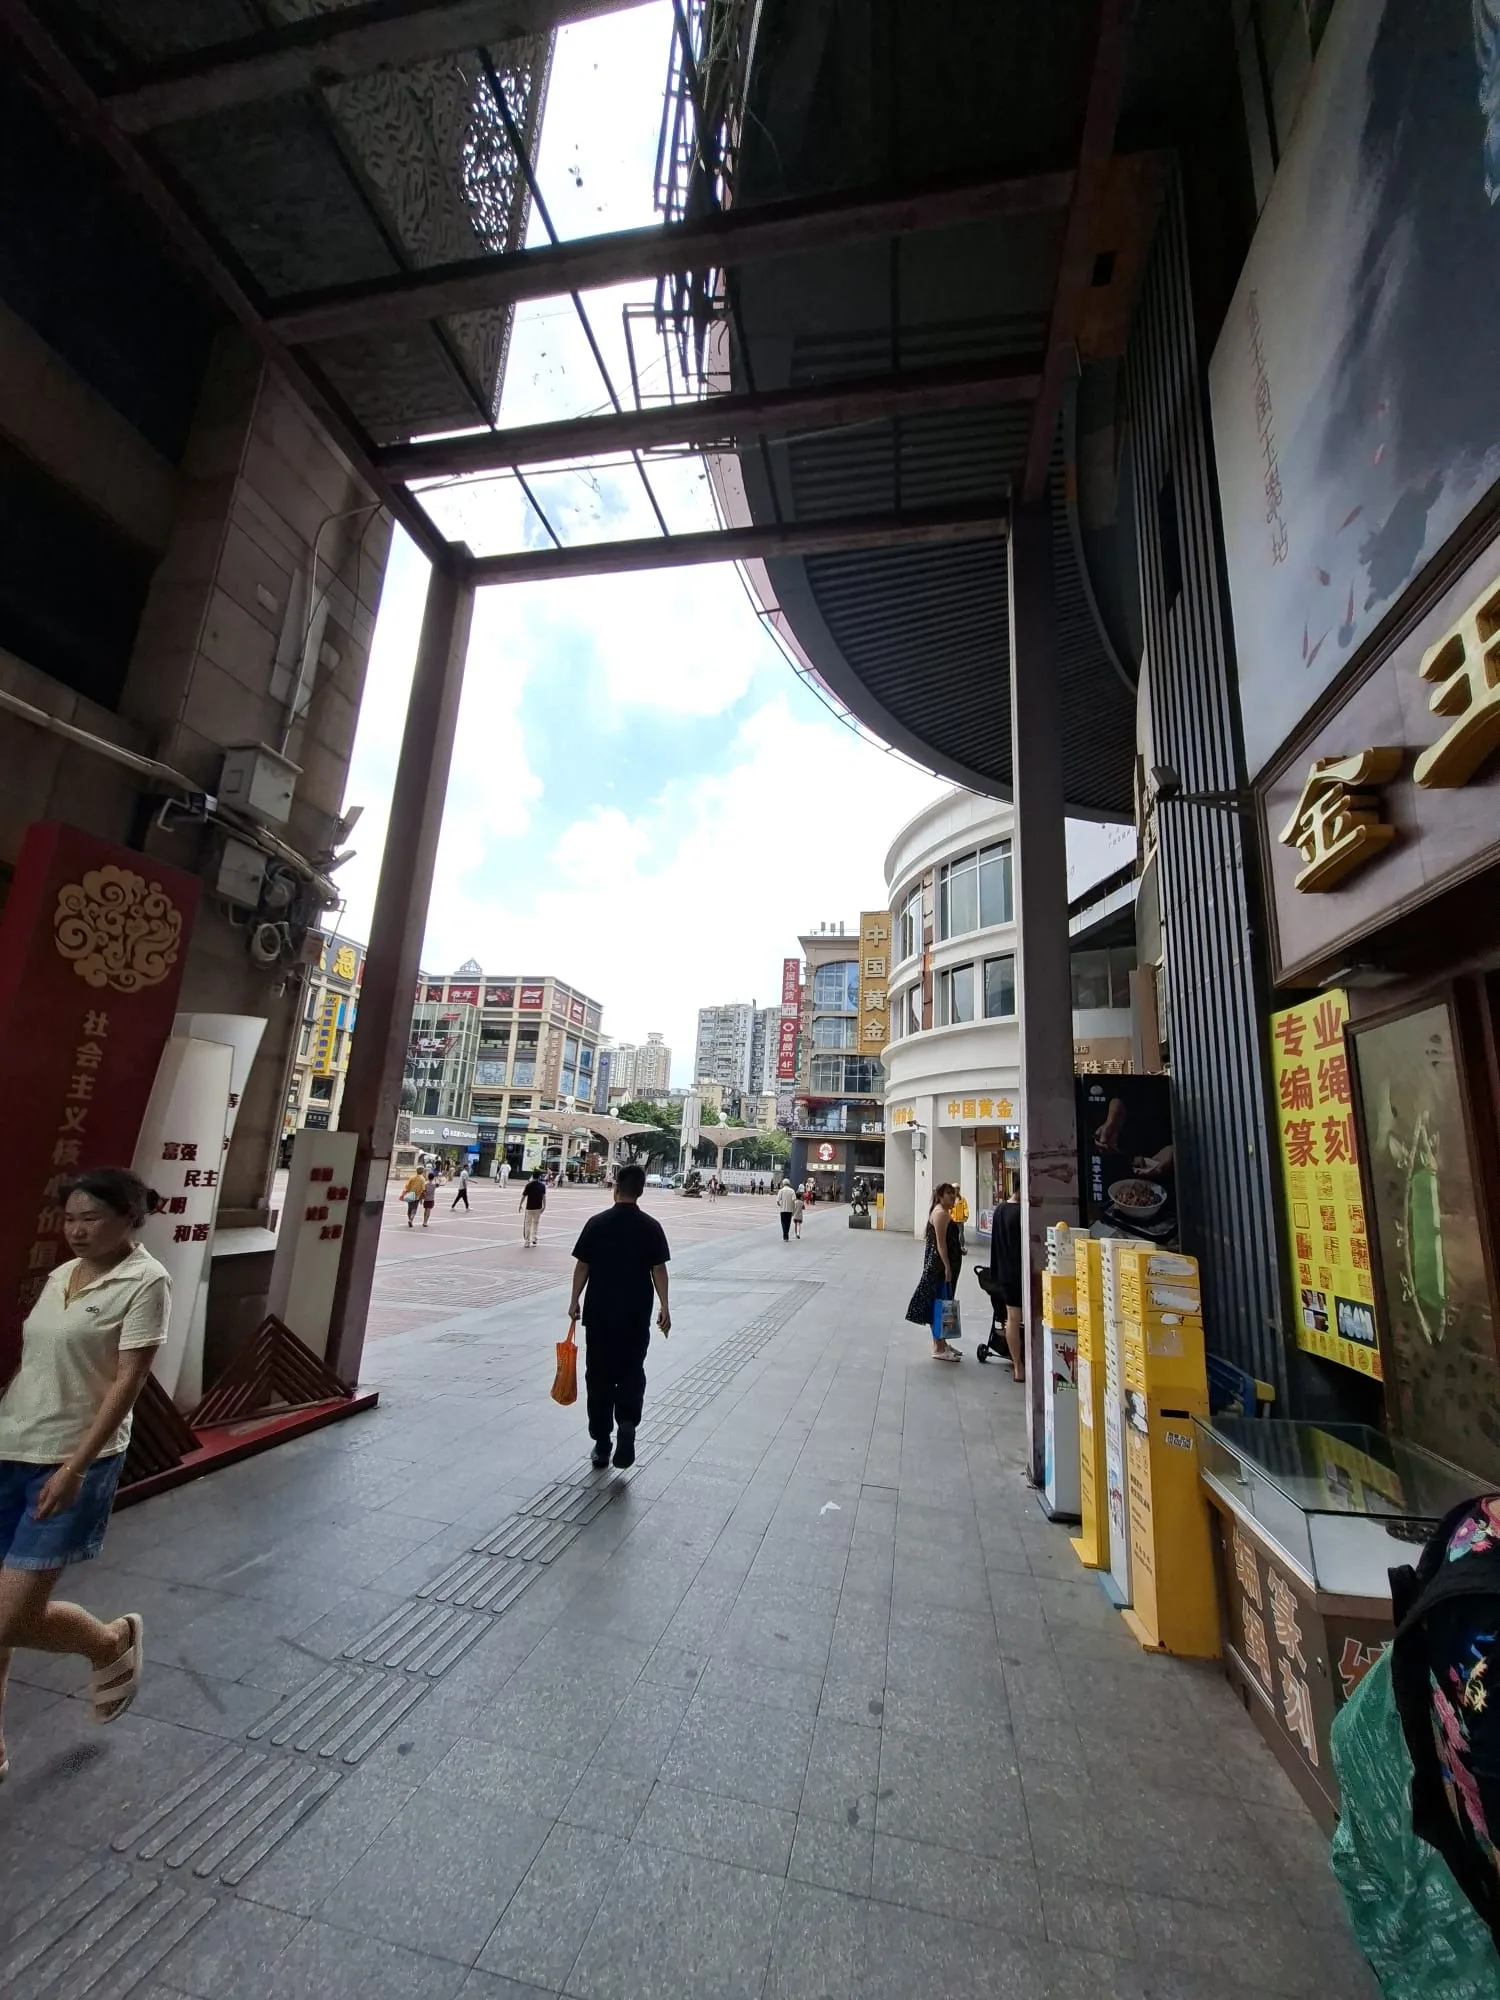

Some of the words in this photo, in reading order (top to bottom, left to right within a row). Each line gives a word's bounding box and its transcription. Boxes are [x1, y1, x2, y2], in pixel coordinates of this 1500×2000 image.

[784, 961, 798, 1001] 木屋烧烤
[863, 923, 889, 1042] 中国黄金
[1275, 999, 1344, 1058] 专业
[781, 1060, 793, 1069] 4F
[1279, 1055, 1350, 1112] 编绳
[947, 1097, 1013, 1120] 中国黄金
[162, 1142, 198, 1161] 富强
[1285, 1114, 1358, 1168] 篆刻
[184, 1170, 219, 1188] 民主
[150, 1197, 187, 1215] 文明
[173, 1224, 211, 1243] 和谐
[1267, 1566, 1320, 1768] 篆刻
